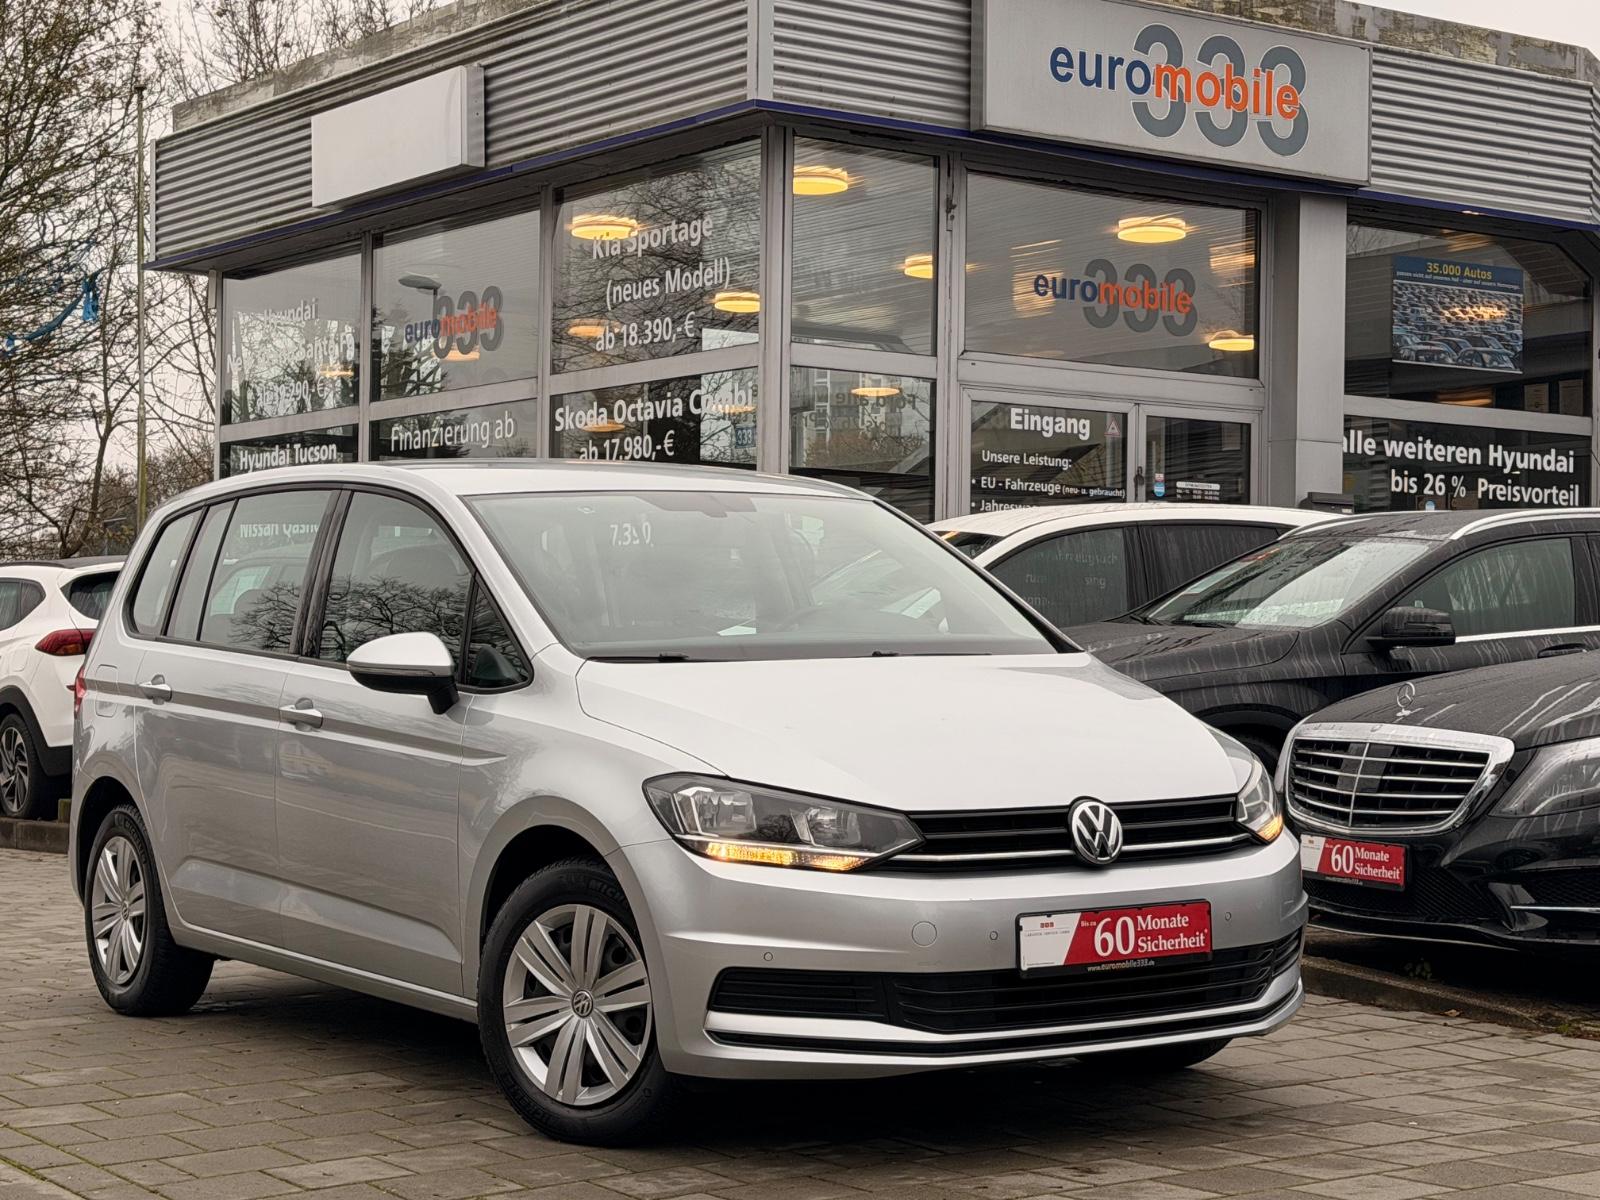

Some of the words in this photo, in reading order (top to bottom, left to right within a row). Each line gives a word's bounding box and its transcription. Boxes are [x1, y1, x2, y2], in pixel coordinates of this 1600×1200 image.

[1050, 45, 1301, 121] euromobile
[1132, 23, 1310, 157] 333
[627, 215, 714, 258] Sportage
[606, 277, 660, 311] (neues
[665, 257, 731, 294] Modell)
[1426, 262, 1461, 276] 35.000
[1464, 267, 1492, 280] Autos
[1033, 274, 1193, 314] euromobile
[1083, 259, 1198, 337] 333
[405, 303, 498, 343] euromobile
[595, 325, 615, 352] ab
[391, 420, 490, 452] Finanzierung
[495, 411, 515, 439] ab
[555, 402, 608, 432] Skoda
[613, 392, 683, 423] Octavia
[1010, 408, 1091, 440] Eingang
[240, 443, 290, 473] Hyundai
[293, 443, 338, 464] Tucson
[579, 440, 599, 461] ab
[982, 450, 1021, 464] Unsere
[1023, 453, 1072, 470] Leistung:
[1383, 436, 1482, 465] weiteren
[1489, 444, 1575, 474] Hyundai
[981, 477, 996, 489] EU
[1005, 478, 1061, 495] Fahrzeuge
[1089, 488, 1126, 498] gebraucht)
[1391, 469, 1418, 493] bis
[1423, 473, 1446, 496] 26
[1451, 475, 1466, 498] %
[1477, 478, 1580, 507] Preisvorteil
[1331, 844, 1354, 874] 60
[1354, 846, 1390, 862] Monate
[1094, 916, 1136, 957] 60
[1137, 913, 1190, 931] Monate
